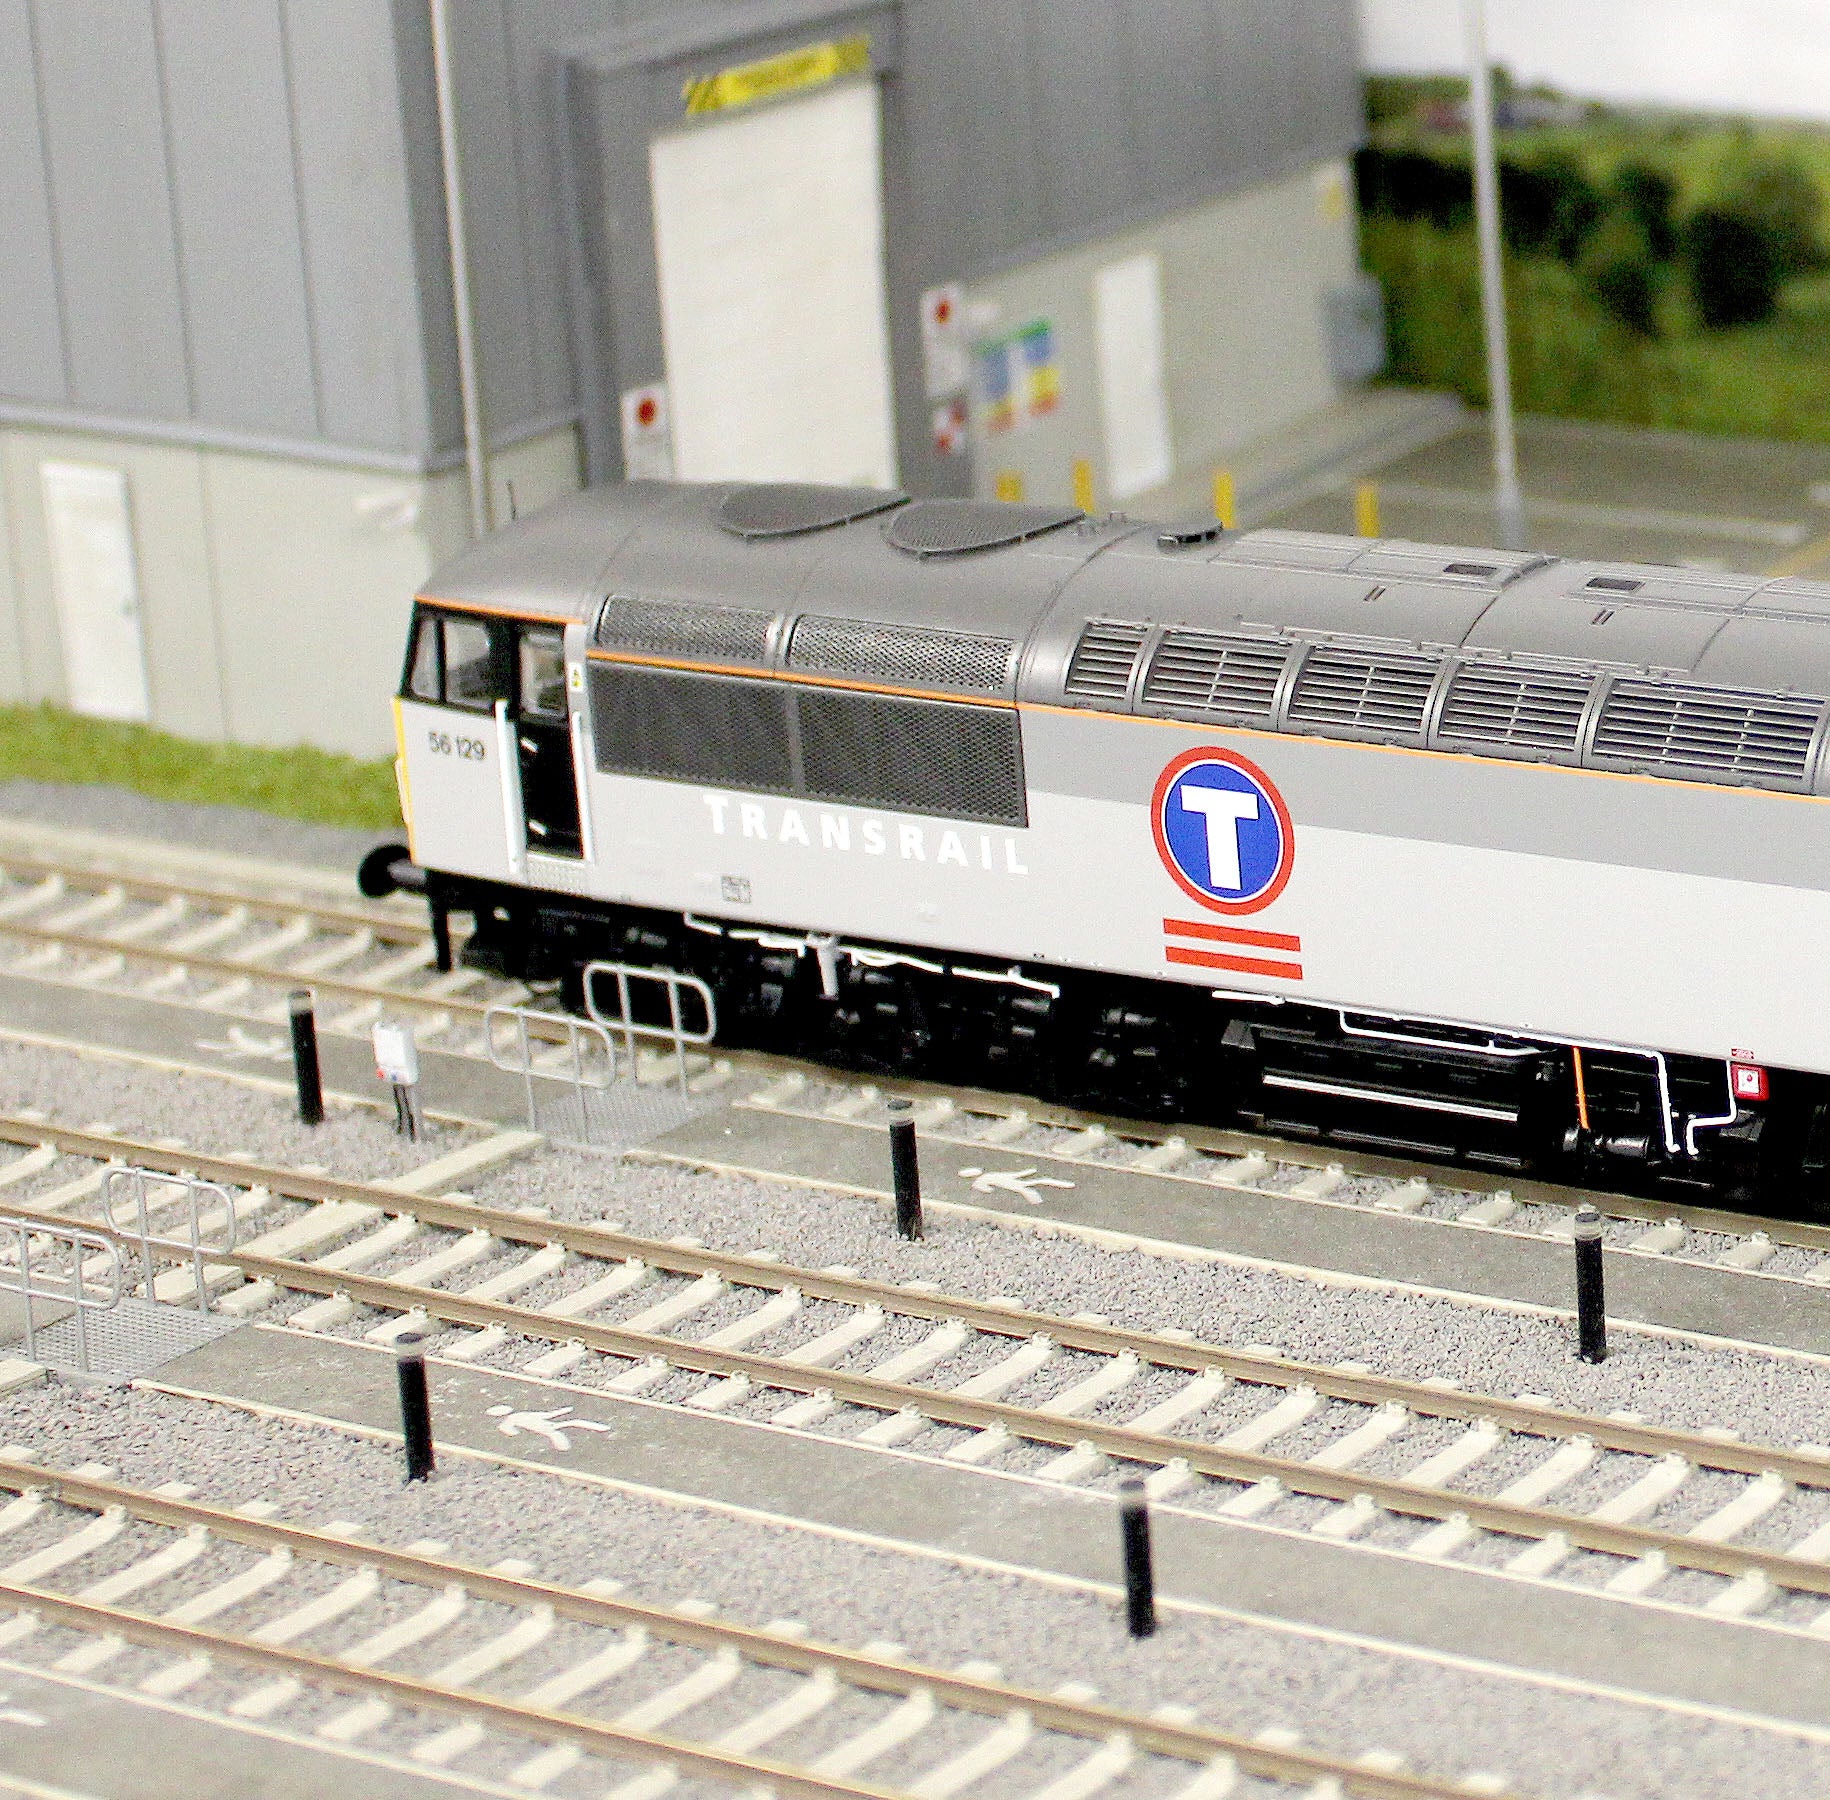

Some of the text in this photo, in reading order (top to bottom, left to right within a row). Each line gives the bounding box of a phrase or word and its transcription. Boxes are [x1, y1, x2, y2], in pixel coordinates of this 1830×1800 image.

[428, 731, 486, 760] 56 129
[702, 793, 1029, 875] TRANSRAIL
[1180, 784, 1260, 891] T
